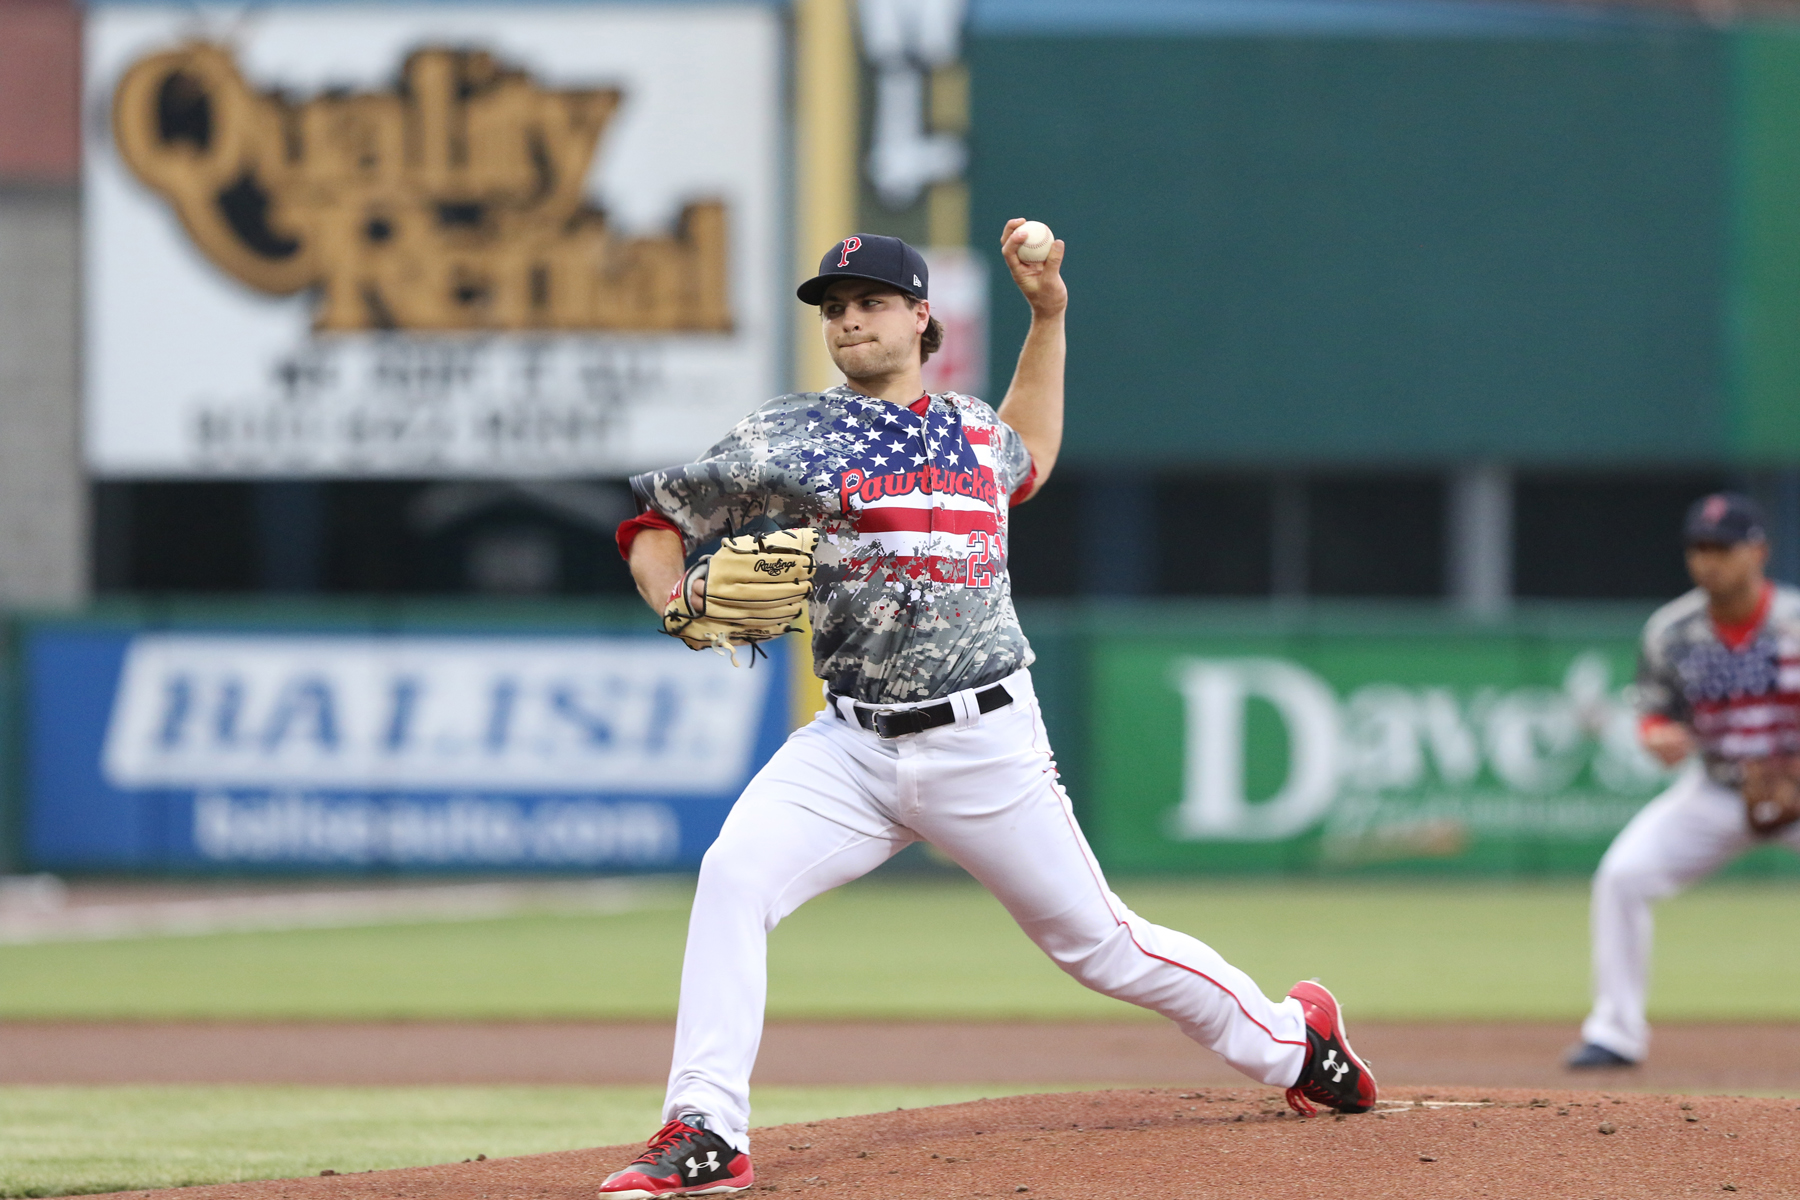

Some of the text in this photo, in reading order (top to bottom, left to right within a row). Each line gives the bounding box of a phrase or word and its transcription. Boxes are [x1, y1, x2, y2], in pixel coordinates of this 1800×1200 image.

[112, 42, 624, 295] Quality
[837, 236, 862, 268] P
[754, 558, 797, 575] Rawlings
